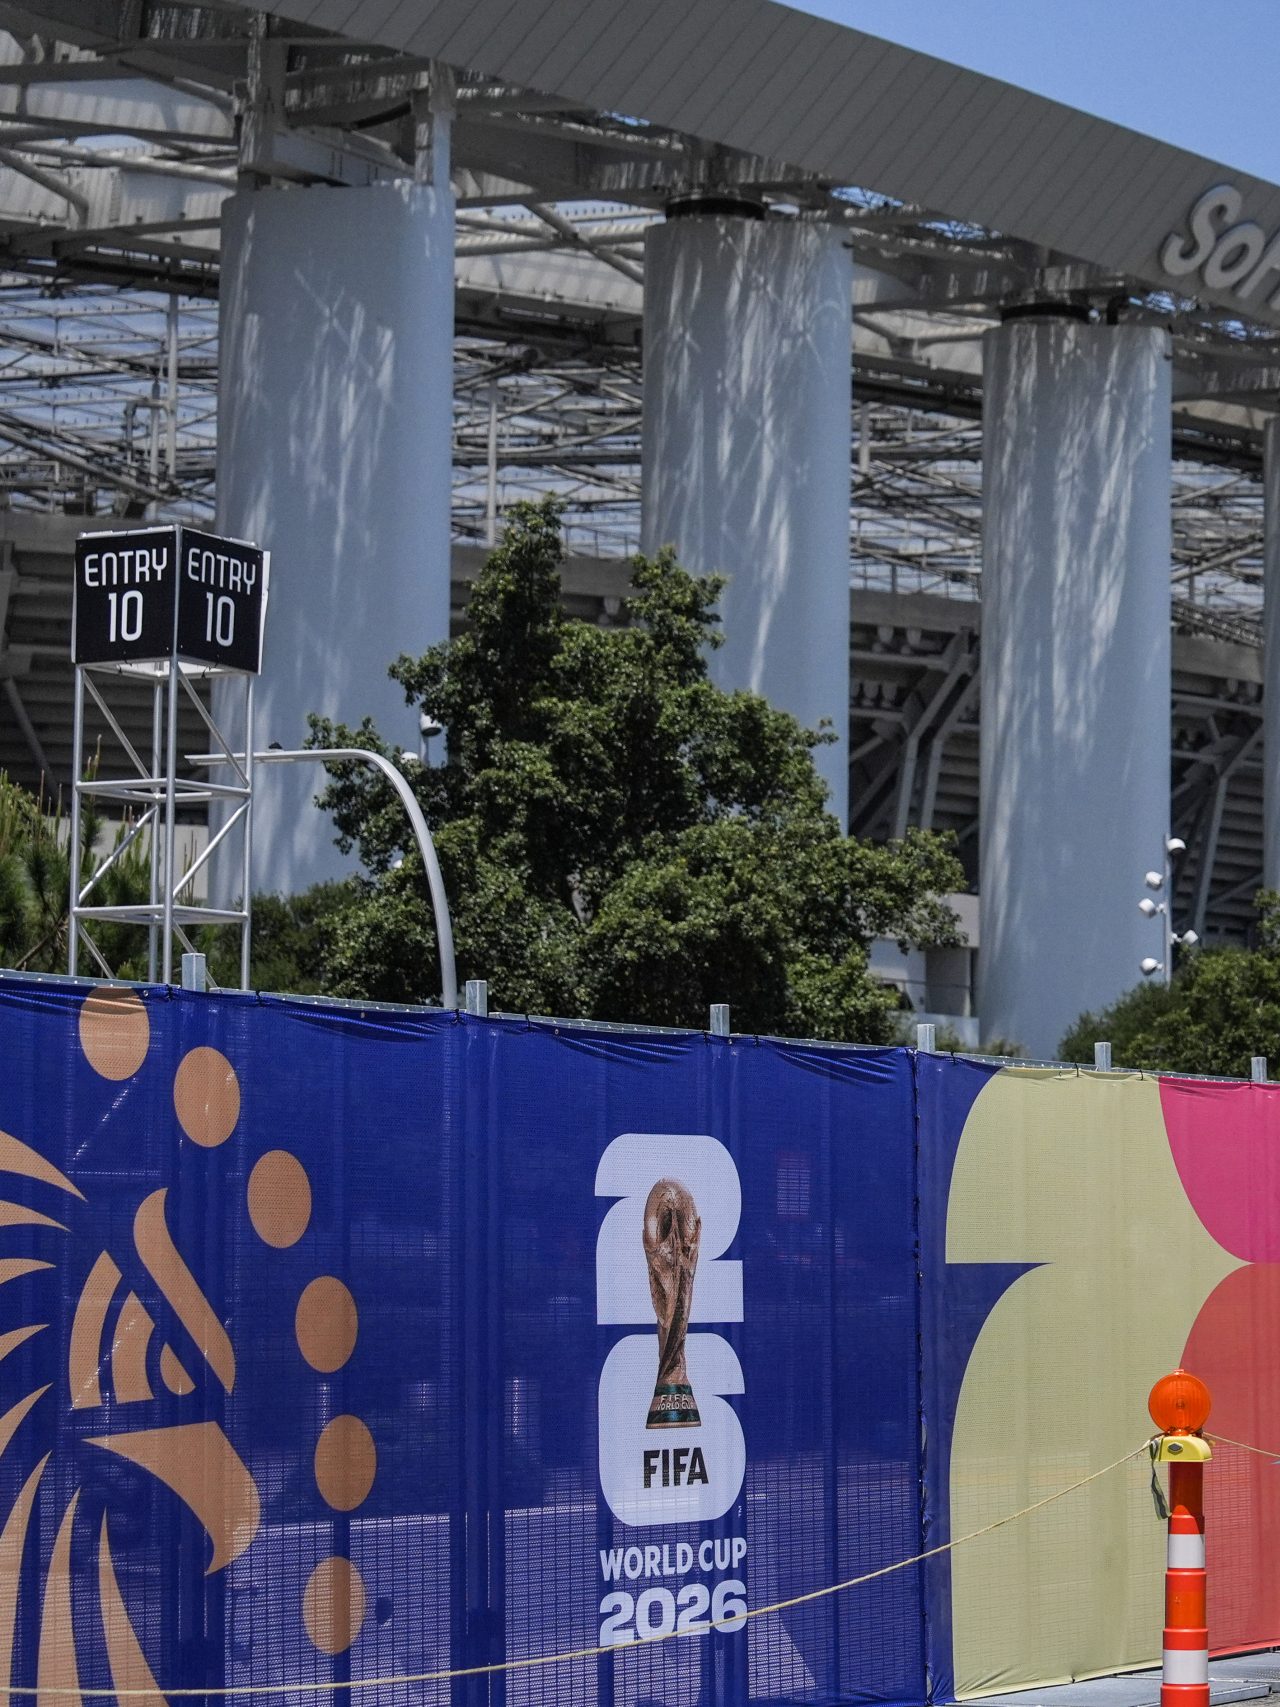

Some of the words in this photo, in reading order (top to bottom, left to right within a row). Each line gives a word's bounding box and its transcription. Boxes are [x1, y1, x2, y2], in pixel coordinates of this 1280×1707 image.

[85, 548, 167, 587] ENTRY
[188, 548, 256, 595] ENTRY
[108, 590, 143, 642] 10
[206, 592, 235, 646] 10
[660, 1394, 688, 1402] FIFA
[643, 1447, 709, 1488] FIFA
[600, 1543, 694, 1581] WORLD
[699, 1537, 747, 1571] CUP
[600, 1579, 748, 1647] 2026
